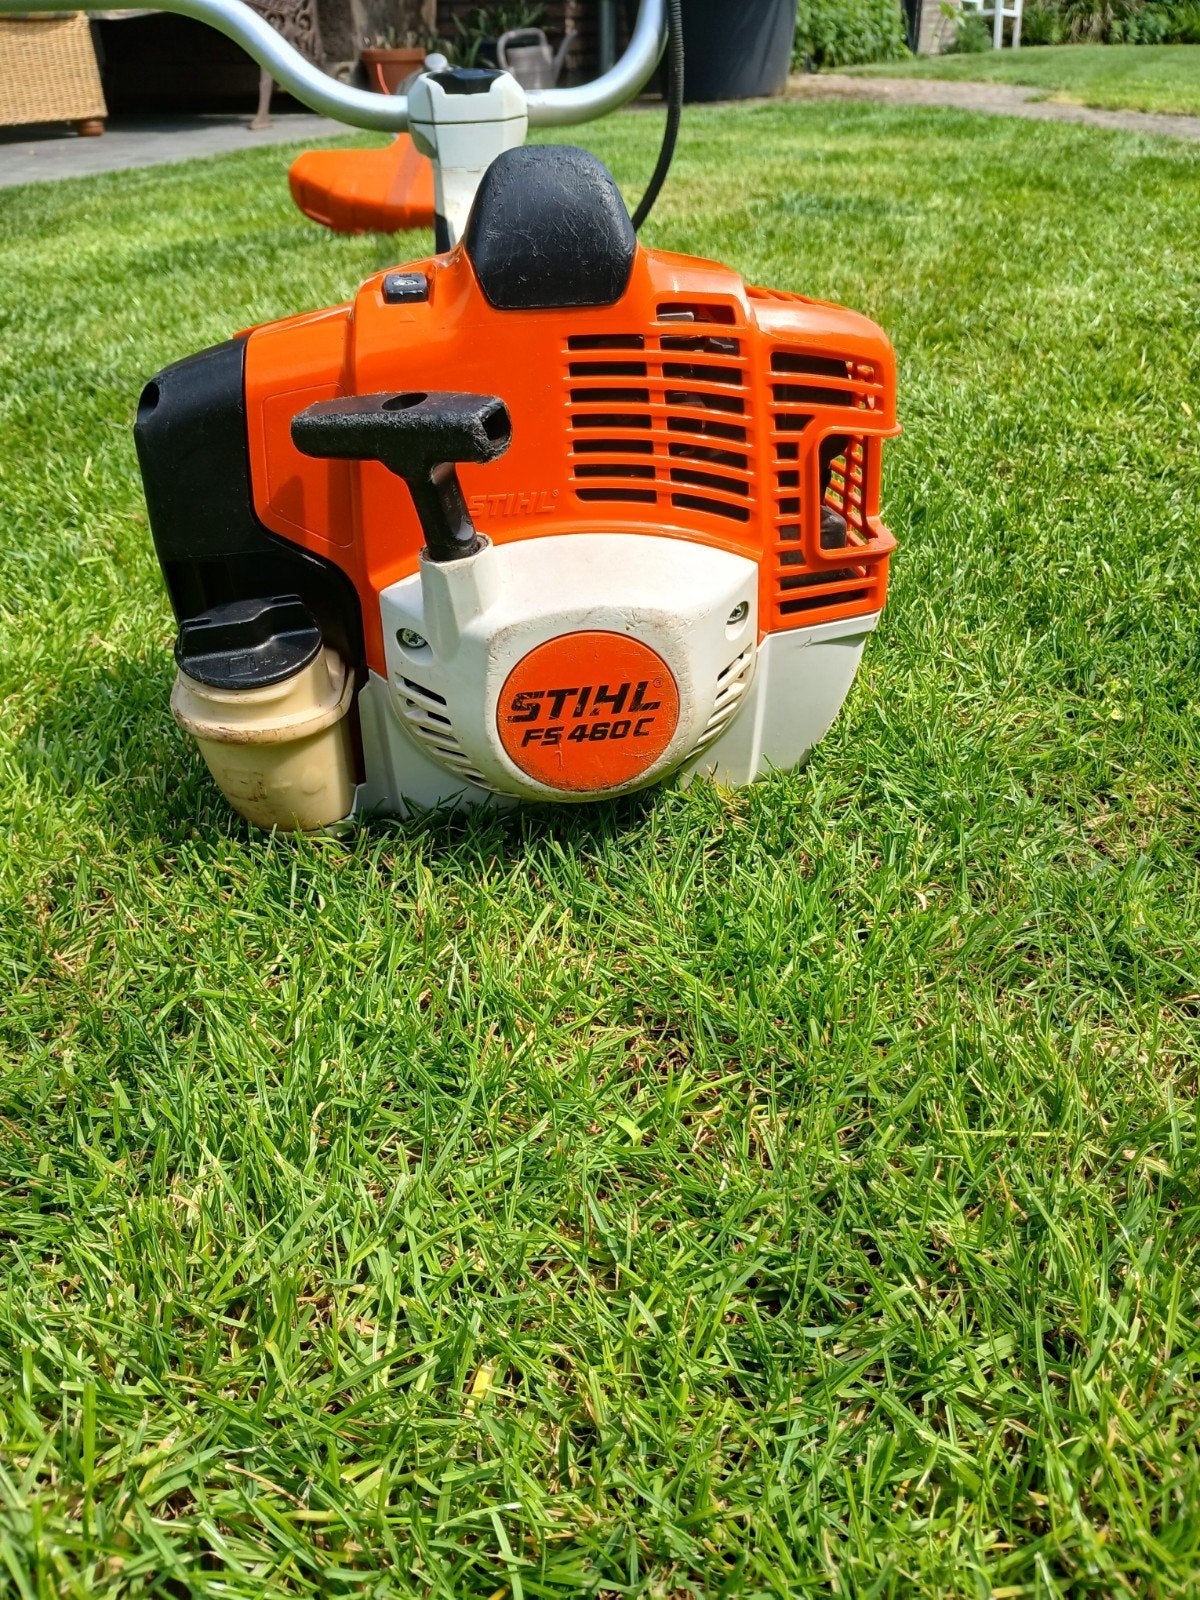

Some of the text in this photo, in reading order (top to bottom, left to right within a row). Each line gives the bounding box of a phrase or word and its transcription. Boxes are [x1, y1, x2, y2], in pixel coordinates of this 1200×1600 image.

[469, 491, 555, 518] STIHL
[508, 680, 661, 723] STIHL
[521, 726, 565, 747] FS
